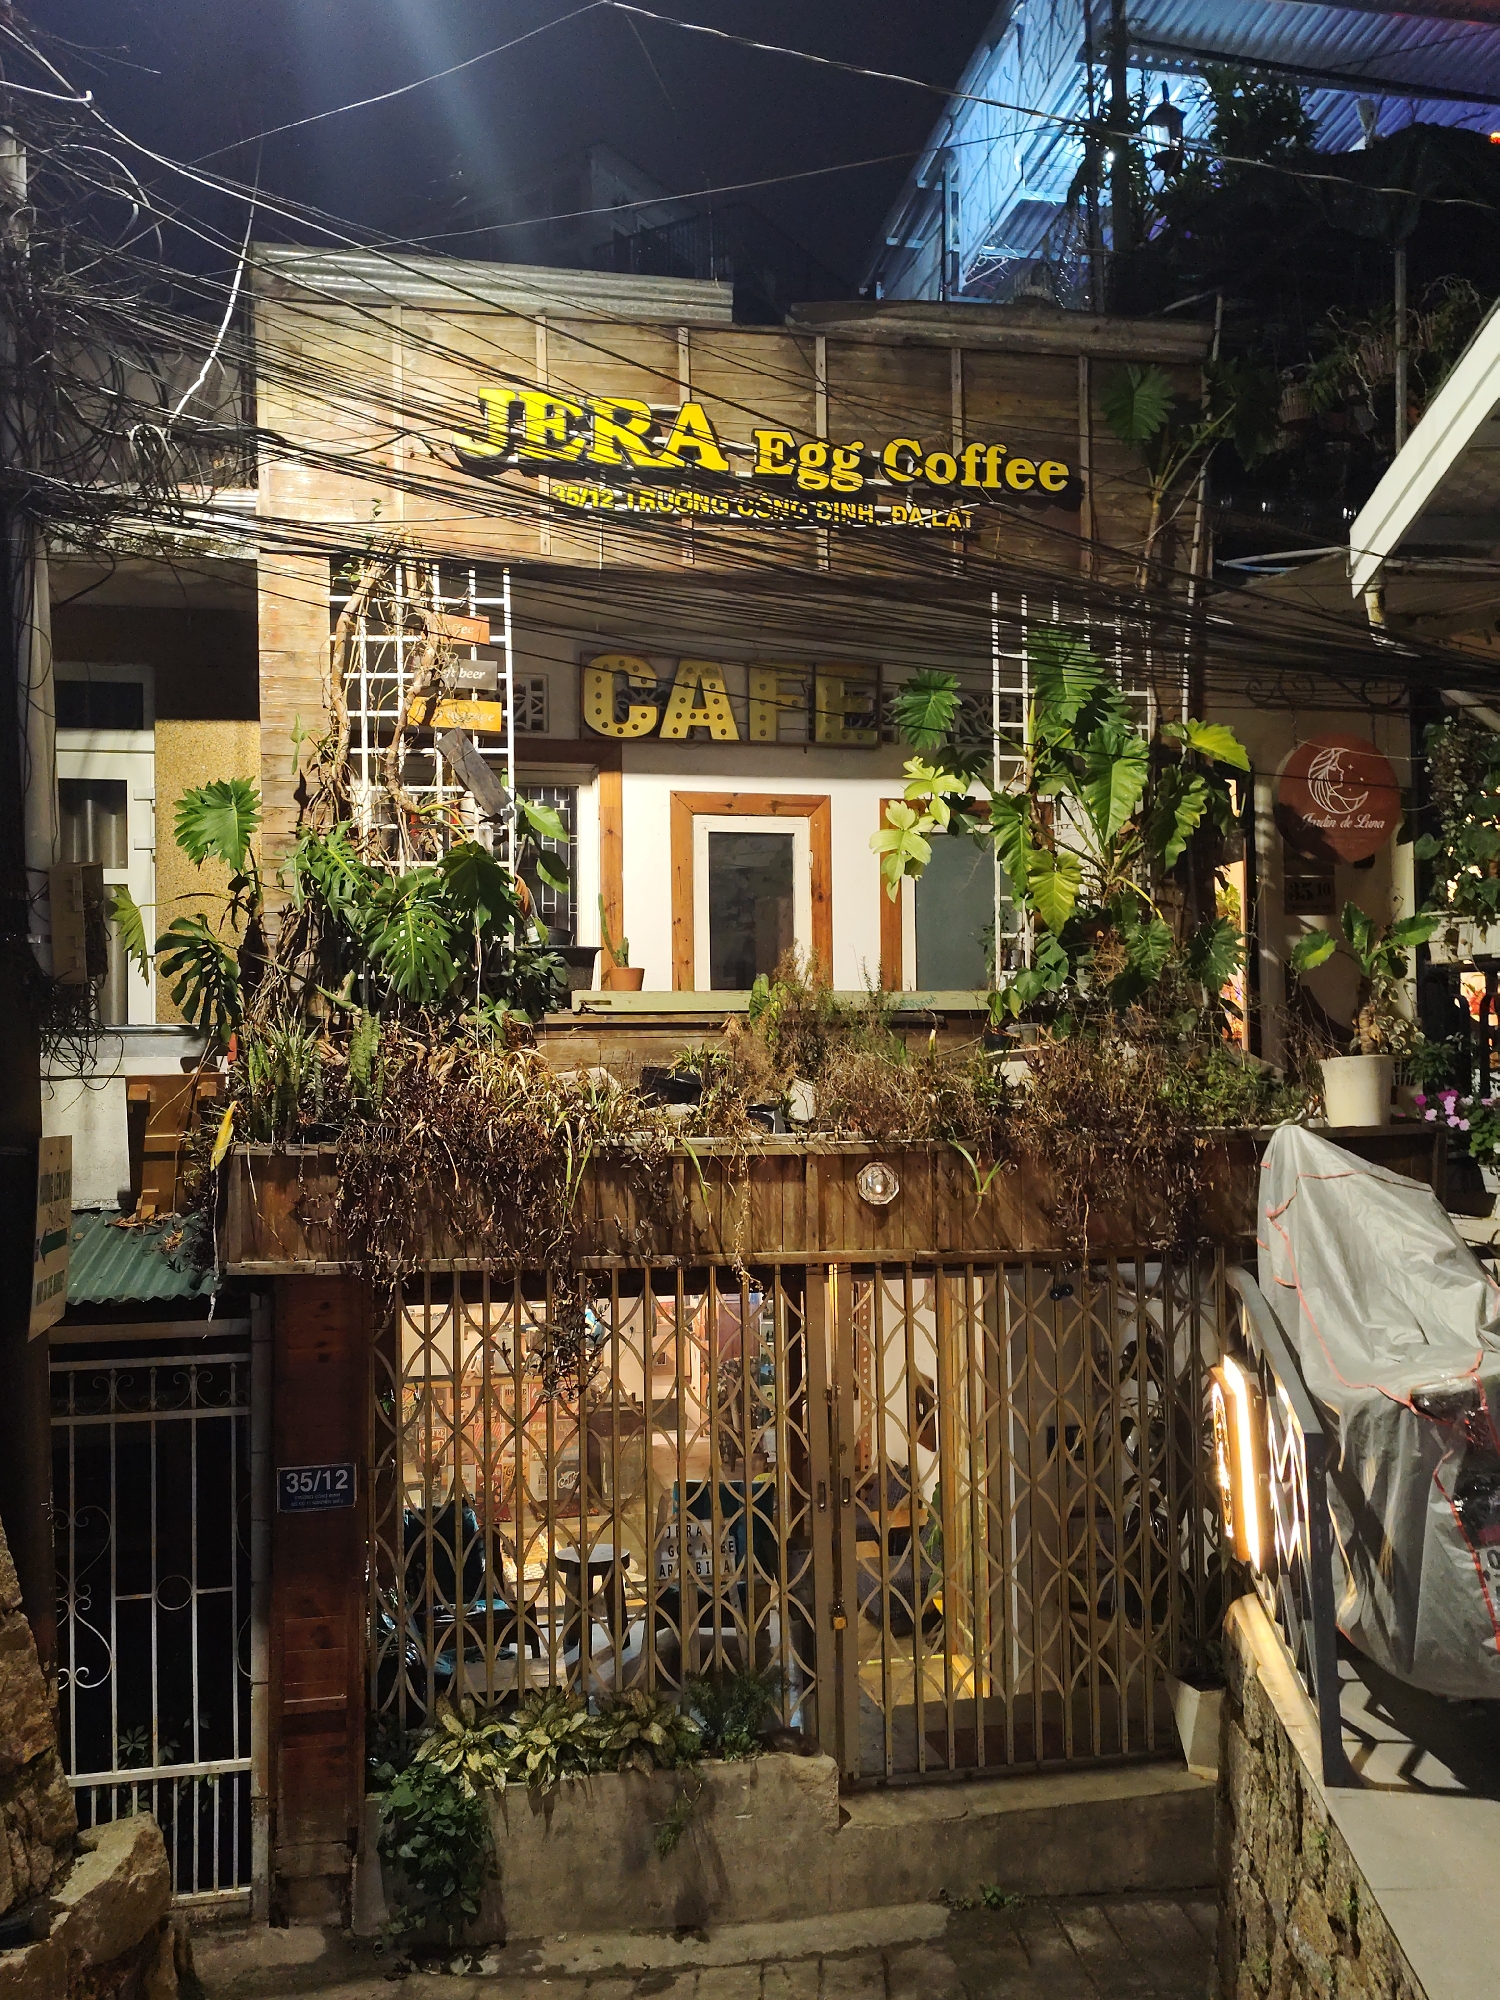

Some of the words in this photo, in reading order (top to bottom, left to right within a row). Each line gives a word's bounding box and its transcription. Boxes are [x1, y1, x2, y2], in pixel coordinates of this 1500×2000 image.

[452, 387, 730, 472] JERA
[753, 430, 864, 492] Egg
[882, 438, 1069, 491] Coffee
[551, 485, 615, 509] 35/12
[459, 667, 486, 679] beer
[584, 655, 879, 741] CAFE
[1340, 814, 1353, 828] de
[1354, 813, 1385, 829] Luna
[286, 1470, 348, 1493] 35/12
